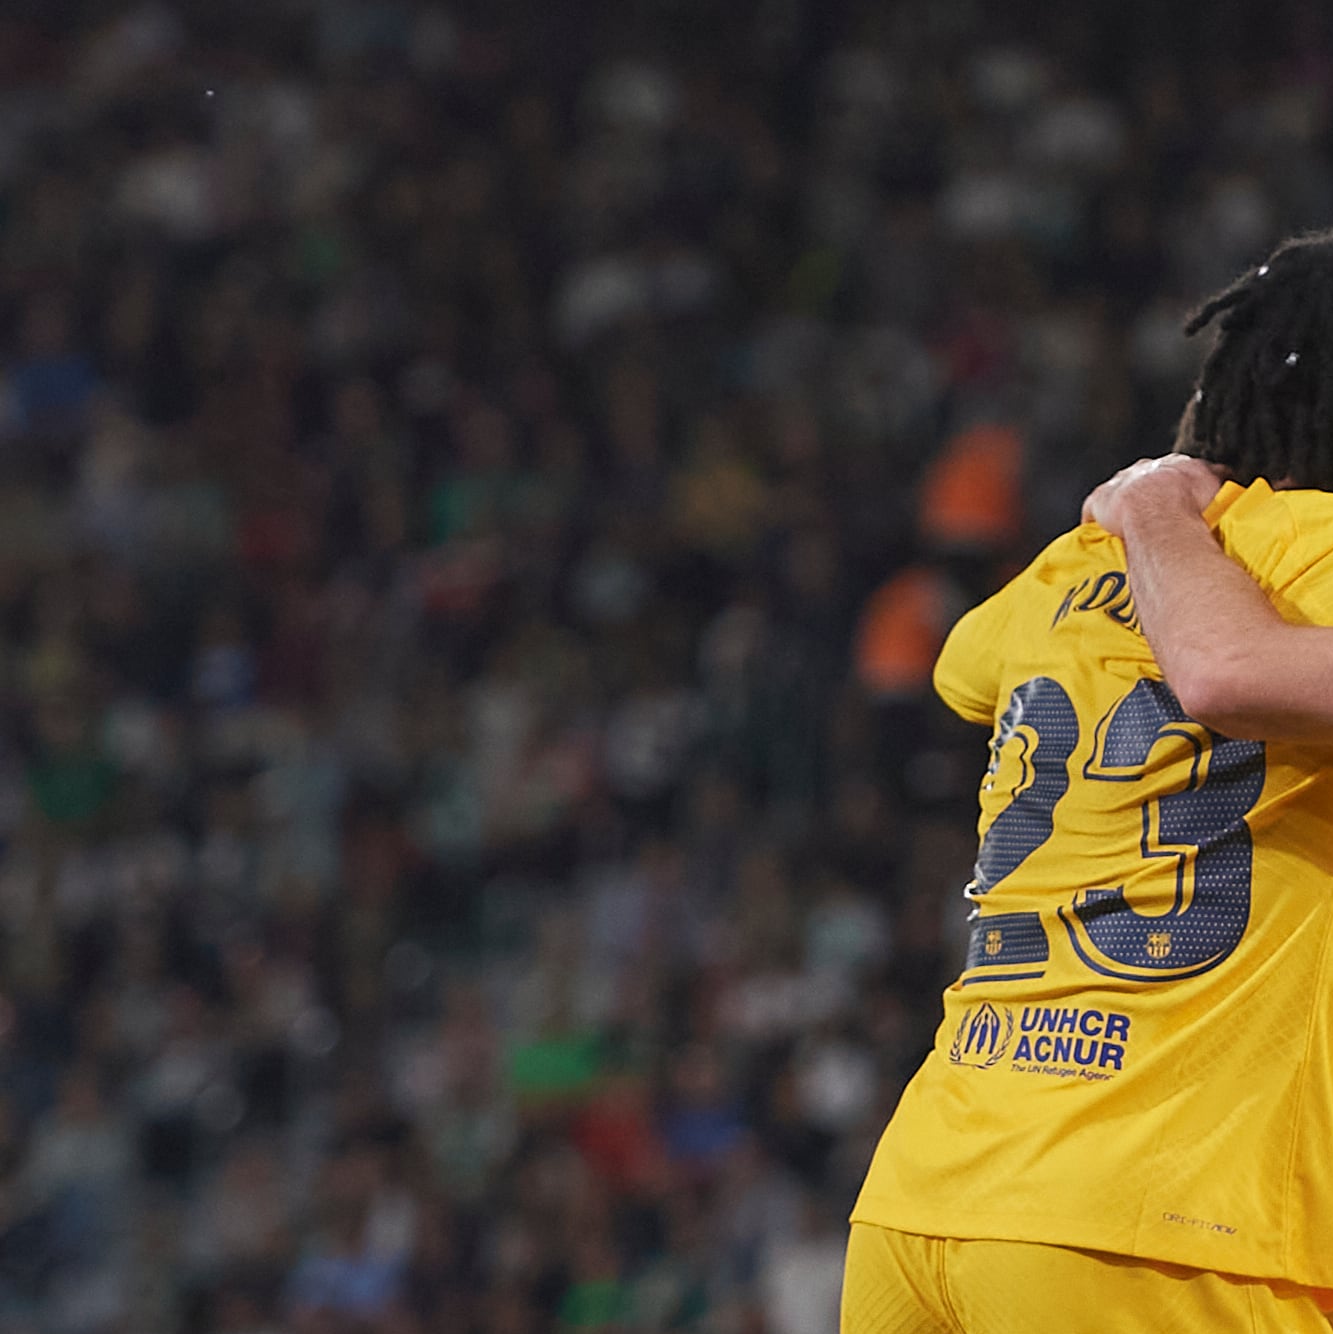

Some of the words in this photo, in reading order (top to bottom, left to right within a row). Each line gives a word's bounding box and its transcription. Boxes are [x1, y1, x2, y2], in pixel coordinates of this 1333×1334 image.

[961, 676, 1267, 983] 23
[1020, 1007, 1130, 1042] UNHCR
[1013, 1035, 1125, 1071] ACNUR
